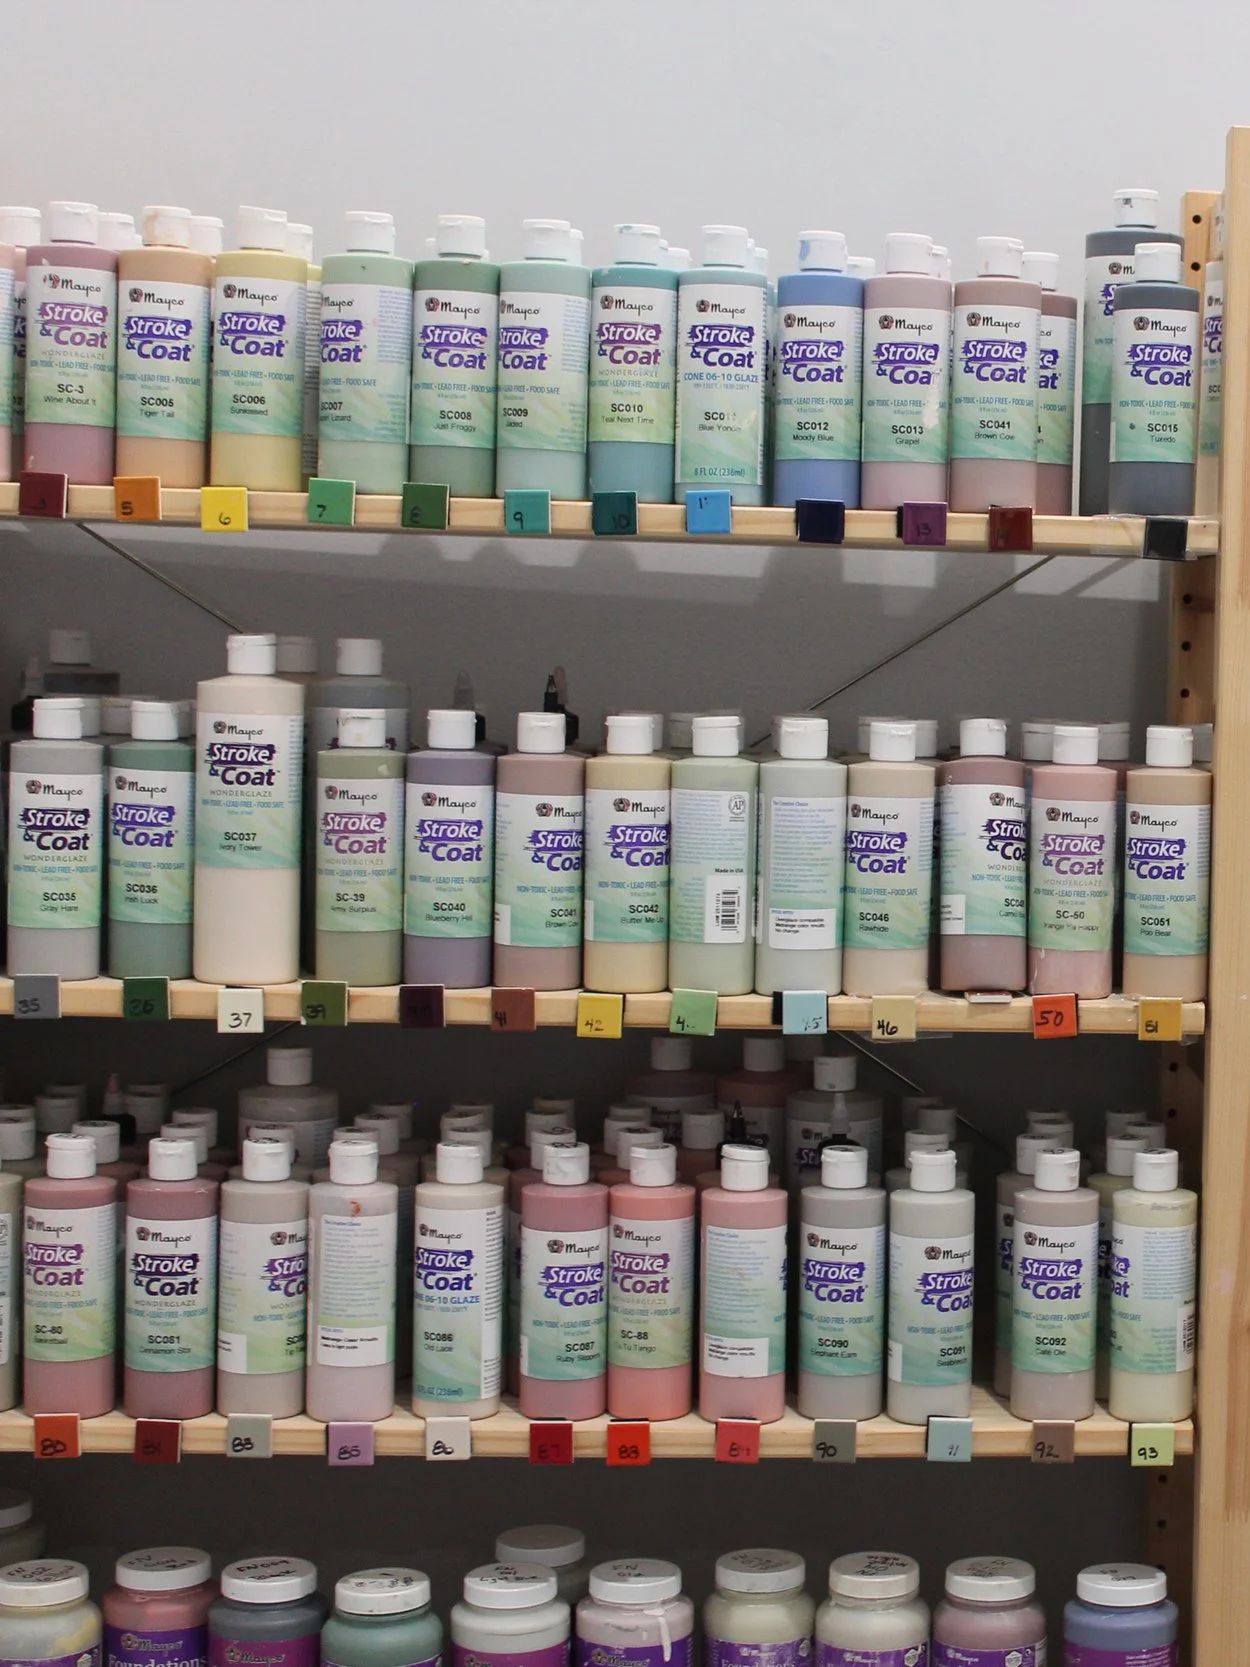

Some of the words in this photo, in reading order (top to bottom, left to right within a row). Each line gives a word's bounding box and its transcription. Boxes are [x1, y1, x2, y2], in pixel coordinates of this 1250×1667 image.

[144, 291, 185, 309] Mayco
[129, 317, 186, 337] Stroke
[223, 313, 280, 333] Stroke
[1151, 320, 1187, 337] Mayco
[601, 325, 657, 342] Stroke
[126, 339, 136, 350] &
[138, 341, 191, 361] Coat
[1137, 346, 1189, 363] Stroke
[684, 372, 702, 381] CONE
[704, 373, 732, 382] 06-10
[734, 374, 758, 382] GLAZE
[1131, 366, 1142, 376] &
[1146, 369, 1192, 386] Coat
[57, 383, 84, 394] SC-3
[140, 397, 174, 407] SC005
[233, 395, 265, 405] SC006
[503, 408, 528, 417] SC009
[611, 404, 643, 413] SC010
[439, 410, 472, 420] SC008
[797, 421, 829, 431] SC012
[891, 425, 924, 435] SC013
[979, 420, 1011, 430] SC041
[1147, 423, 1178, 433] SC015
[817, 433, 833, 441] Blue
[121, 502, 133, 515] 5
[317, 505, 326, 517] 7
[219, 512, 232, 524] 6
[513, 512, 524, 530] 9
[916, 522, 932, 537] 13
[43, 784, 83, 801] Mayco
[25, 811, 85, 828] Stroke
[23, 831, 35, 842] &
[36, 832, 90, 850] Coat
[224, 832, 256, 842] SC037
[852, 833, 902, 851] Stroke
[126, 884, 157, 894] SC036
[43, 892, 76, 901] SC035
[336, 893, 365, 902] SC-39
[433, 902, 465, 912] SC040
[629, 904, 658, 914] SC042
[859, 912, 889, 922] SC046
[1056, 910, 1085, 920] SC-50
[1141, 917, 1170, 926] SC051
[18, 999, 40, 1013] 35
[229, 1013, 253, 1028] 37
[1037, 1011, 1063, 1027] 50
[877, 1020, 898, 1035] 46
[151, 1231, 191, 1247] Mayco
[136, 1256, 194, 1272] Stroke
[807, 1262, 860, 1278] Stroke
[134, 1275, 144, 1286] &
[145, 1278, 198, 1296] Coat
[35, 1326, 62, 1335] SC-80
[621, 1330, 648, 1340] SC-88
[424, 1332, 453, 1342] SC086
[1035, 1337, 1066, 1346] SC092
[565, 1342, 594, 1352] SC087
[818, 1339, 848, 1348] SC090
[940, 1348, 966, 1356] SC091
[816, 1443, 836, 1457] 90
[1035, 1443, 1057, 1458] 92
[1138, 1448, 1158, 1459] 93
